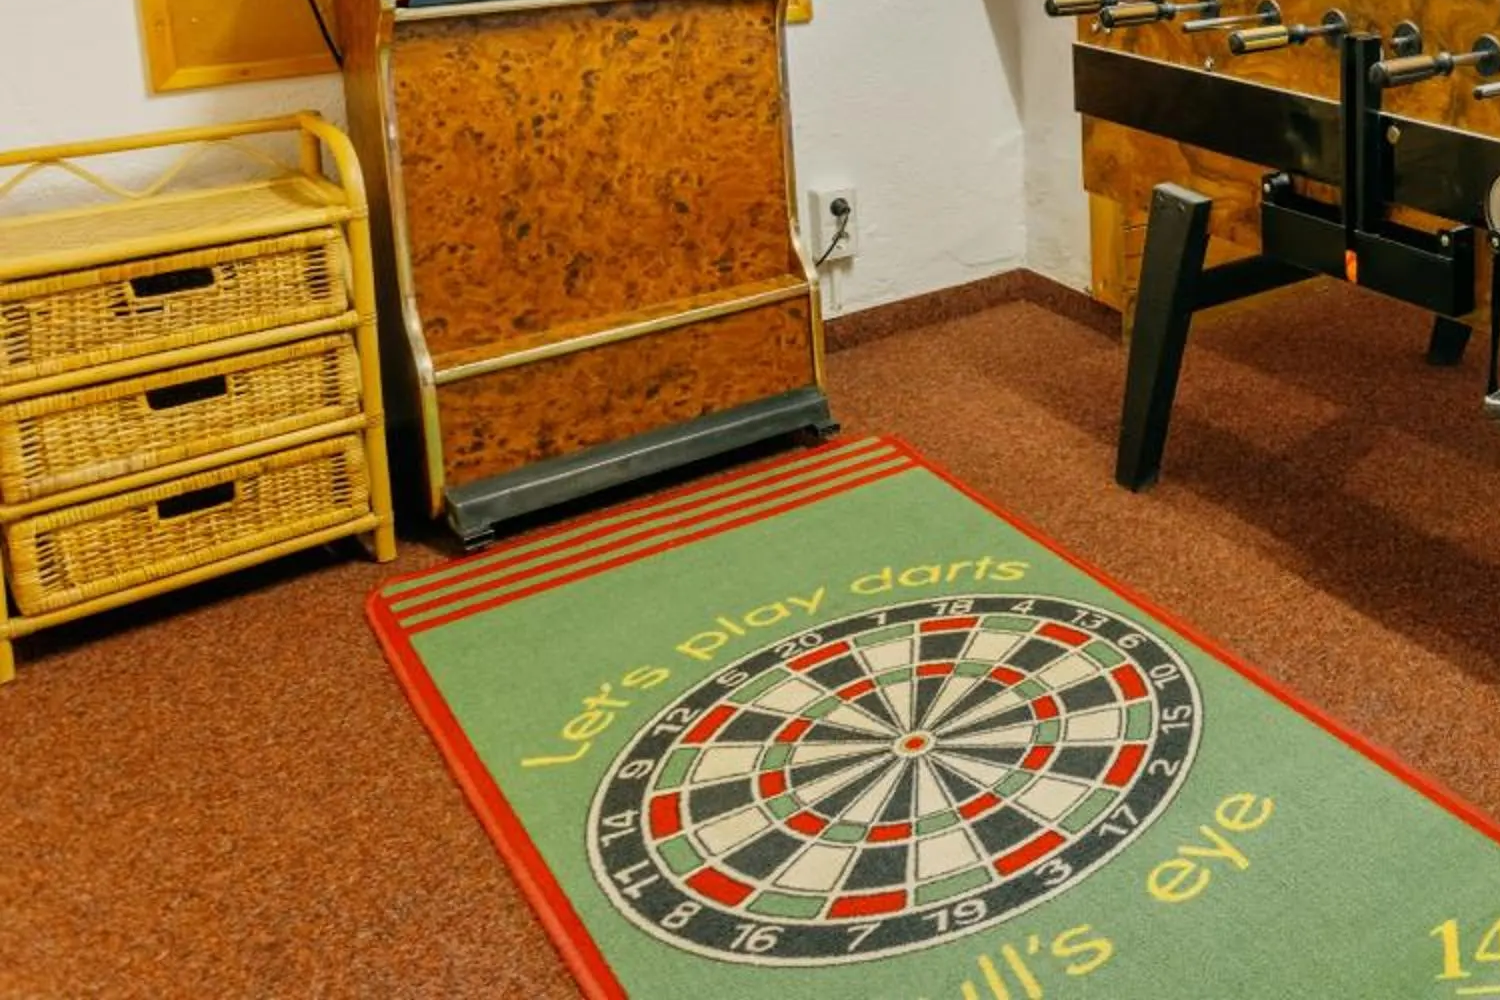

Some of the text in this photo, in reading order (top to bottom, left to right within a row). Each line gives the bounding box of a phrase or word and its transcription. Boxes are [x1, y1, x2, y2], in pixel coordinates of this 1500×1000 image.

[927, 599, 976, 616] 18
[1009, 599, 1035, 616] 4
[1070, 609, 1108, 631] 13
[775, 632, 824, 659] 20
[1116, 633, 1148, 650] 6
[520, 555, 1031, 767] Let's play darts
[716, 668, 750, 688] 5
[1150, 663, 1182, 691] 10
[650, 705, 702, 738] 12
[1161, 704, 1192, 736] 15
[617, 758, 655, 780] 9
[1147, 758, 1179, 777] 2
[600, 808, 640, 848] 14
[1099, 803, 1141, 837] 17
[613, 860, 660, 900] 11
[1034, 858, 1073, 886] 3
[921, 793, 1276, 1000] ll's eye
[660, 900, 701, 929] 8
[921, 899, 989, 933] 19
[729, 923, 785, 952] 16
[846, 921, 883, 952] 7
